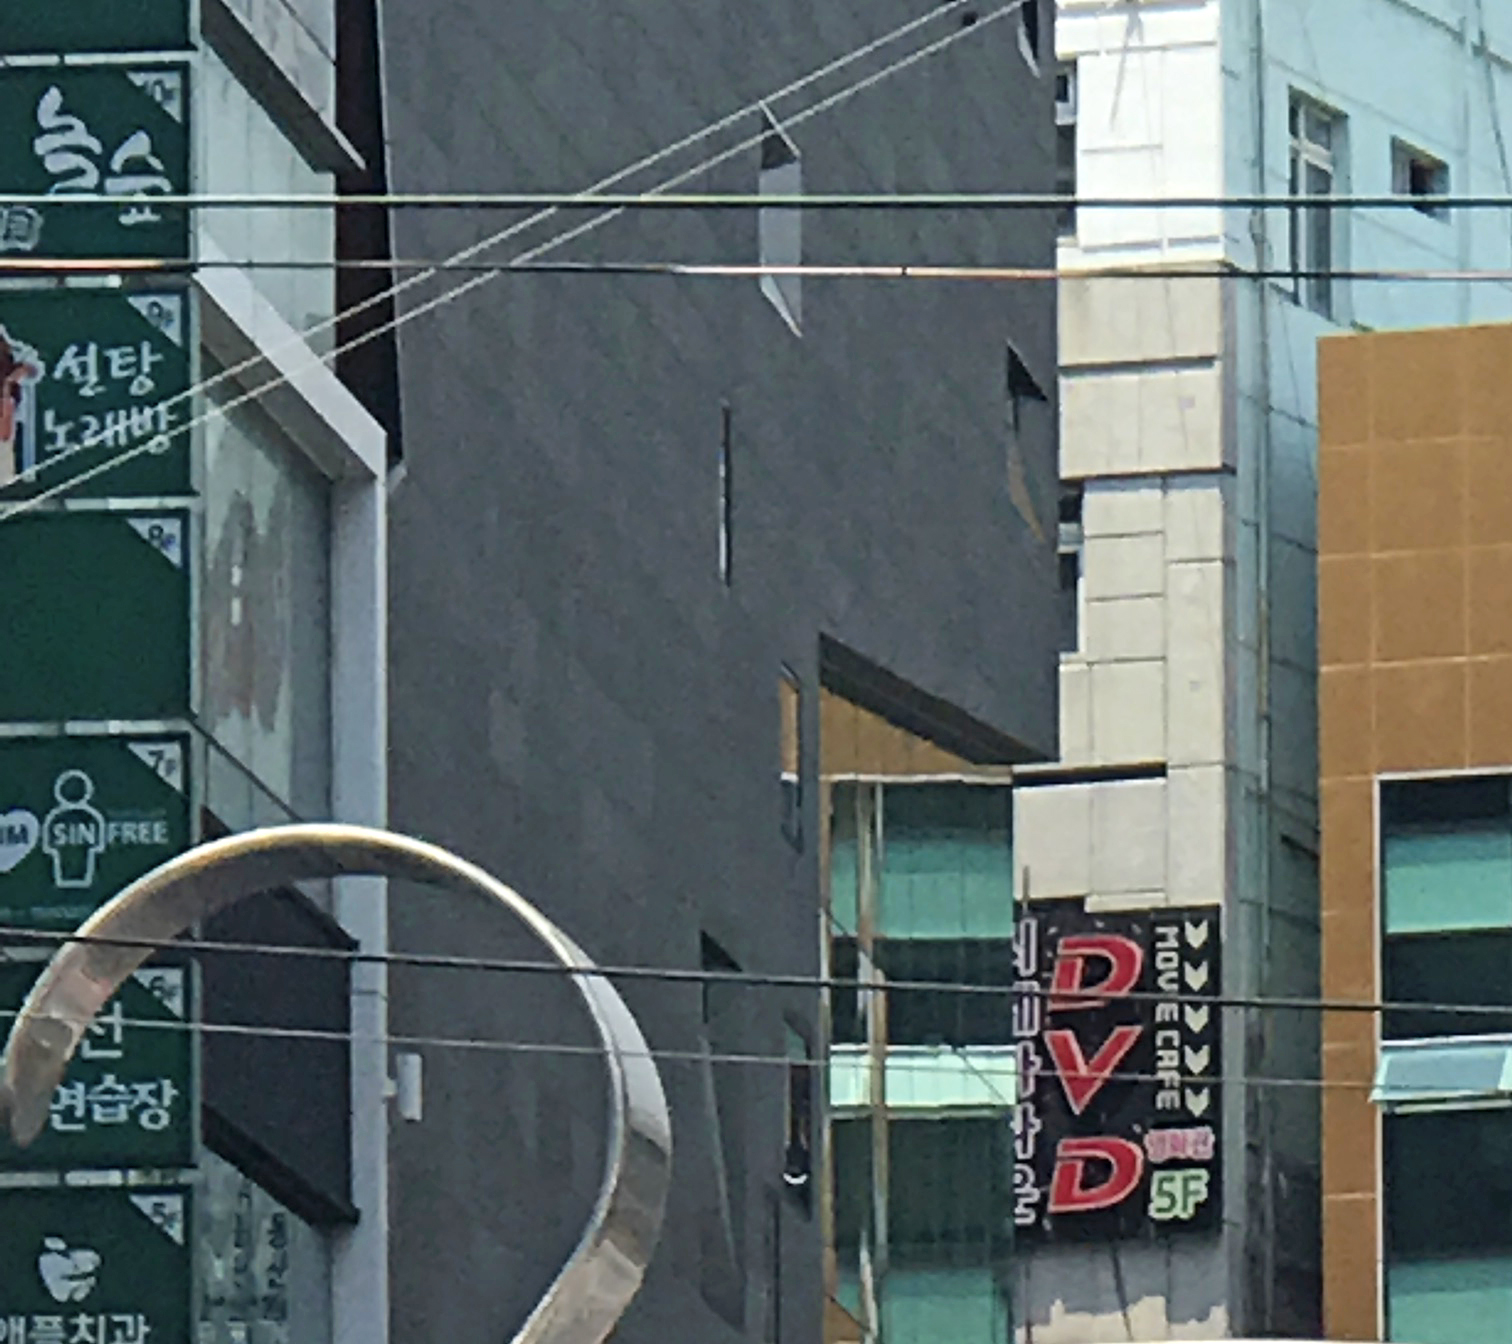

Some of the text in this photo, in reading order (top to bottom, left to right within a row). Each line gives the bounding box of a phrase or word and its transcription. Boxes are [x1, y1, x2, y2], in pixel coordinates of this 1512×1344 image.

[53, 341, 164, 397] 설탕
[44, 401, 178, 454] 노래방
[53, 822, 95, 846] SIN
[107, 820, 168, 845] FREE
[1045, 934, 1144, 1214] DVD
[1155, 1030, 1181, 1111] CAFE
[50, 1074, 178, 1131] 연습장
[1154, 1173, 1205, 1214] 5F
